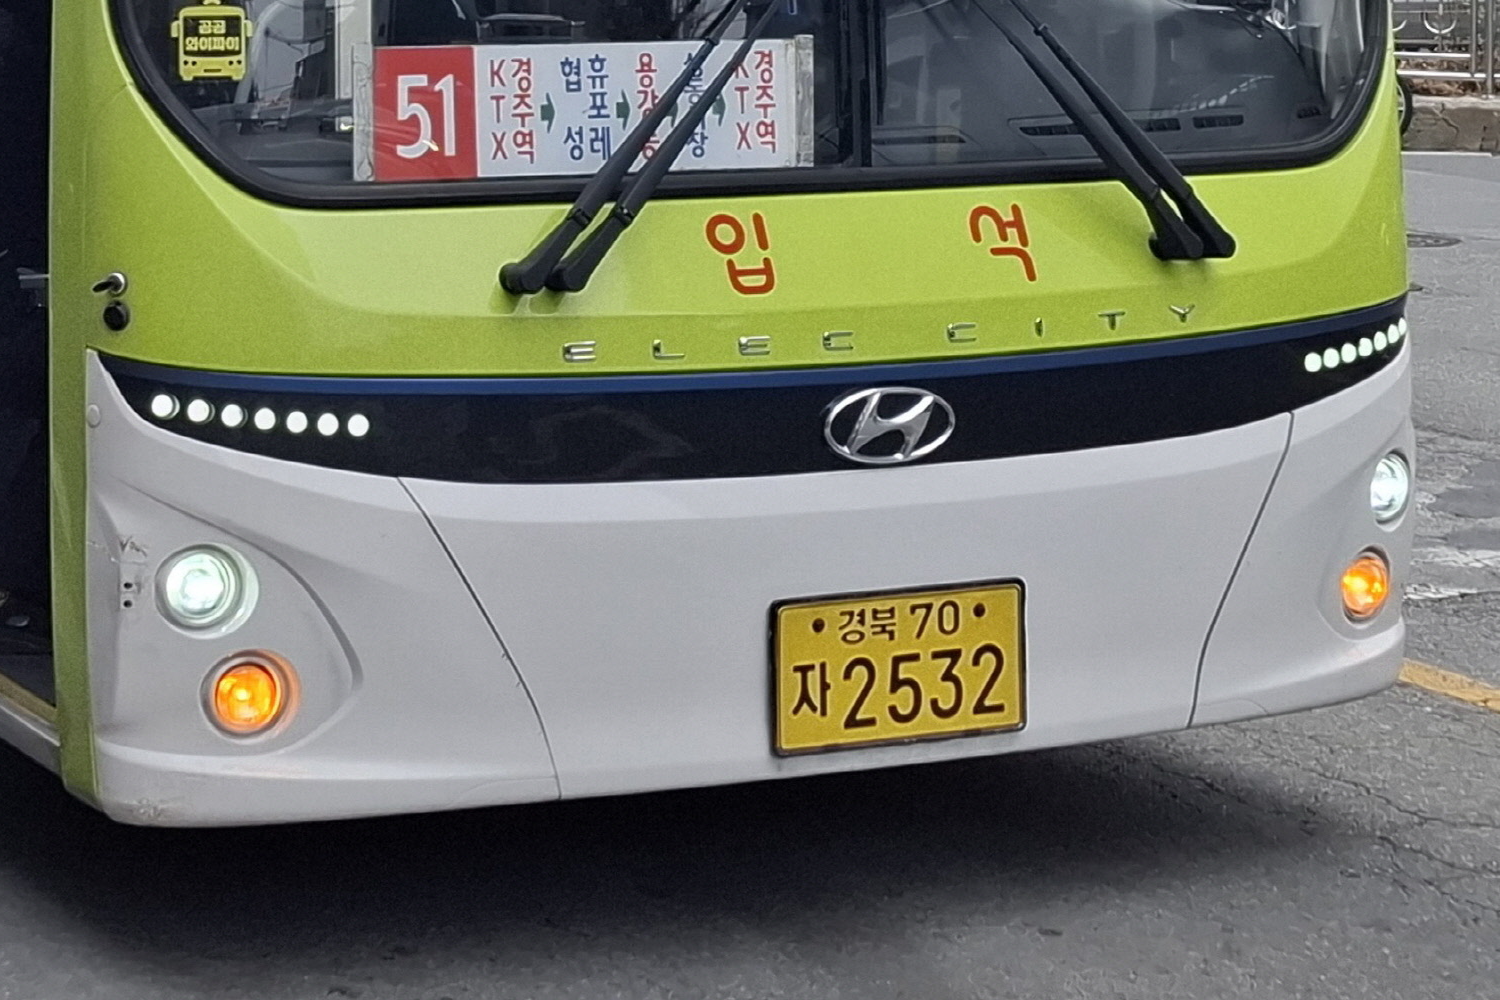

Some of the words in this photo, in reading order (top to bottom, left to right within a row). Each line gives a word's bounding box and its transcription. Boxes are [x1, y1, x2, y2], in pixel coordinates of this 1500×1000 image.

[185, 36, 240, 51] 와이파이
[395, 72, 456, 160] 51
[490, 58, 507, 160] KTX
[511, 57, 535, 164] 경주역
[754, 49, 776, 154] 경주역
[562, 329, 855, 365] ELEC
[945, 303, 1195, 343] CITY
[838, 606, 898, 644] 경북
[910, 600, 960, 639] 70
